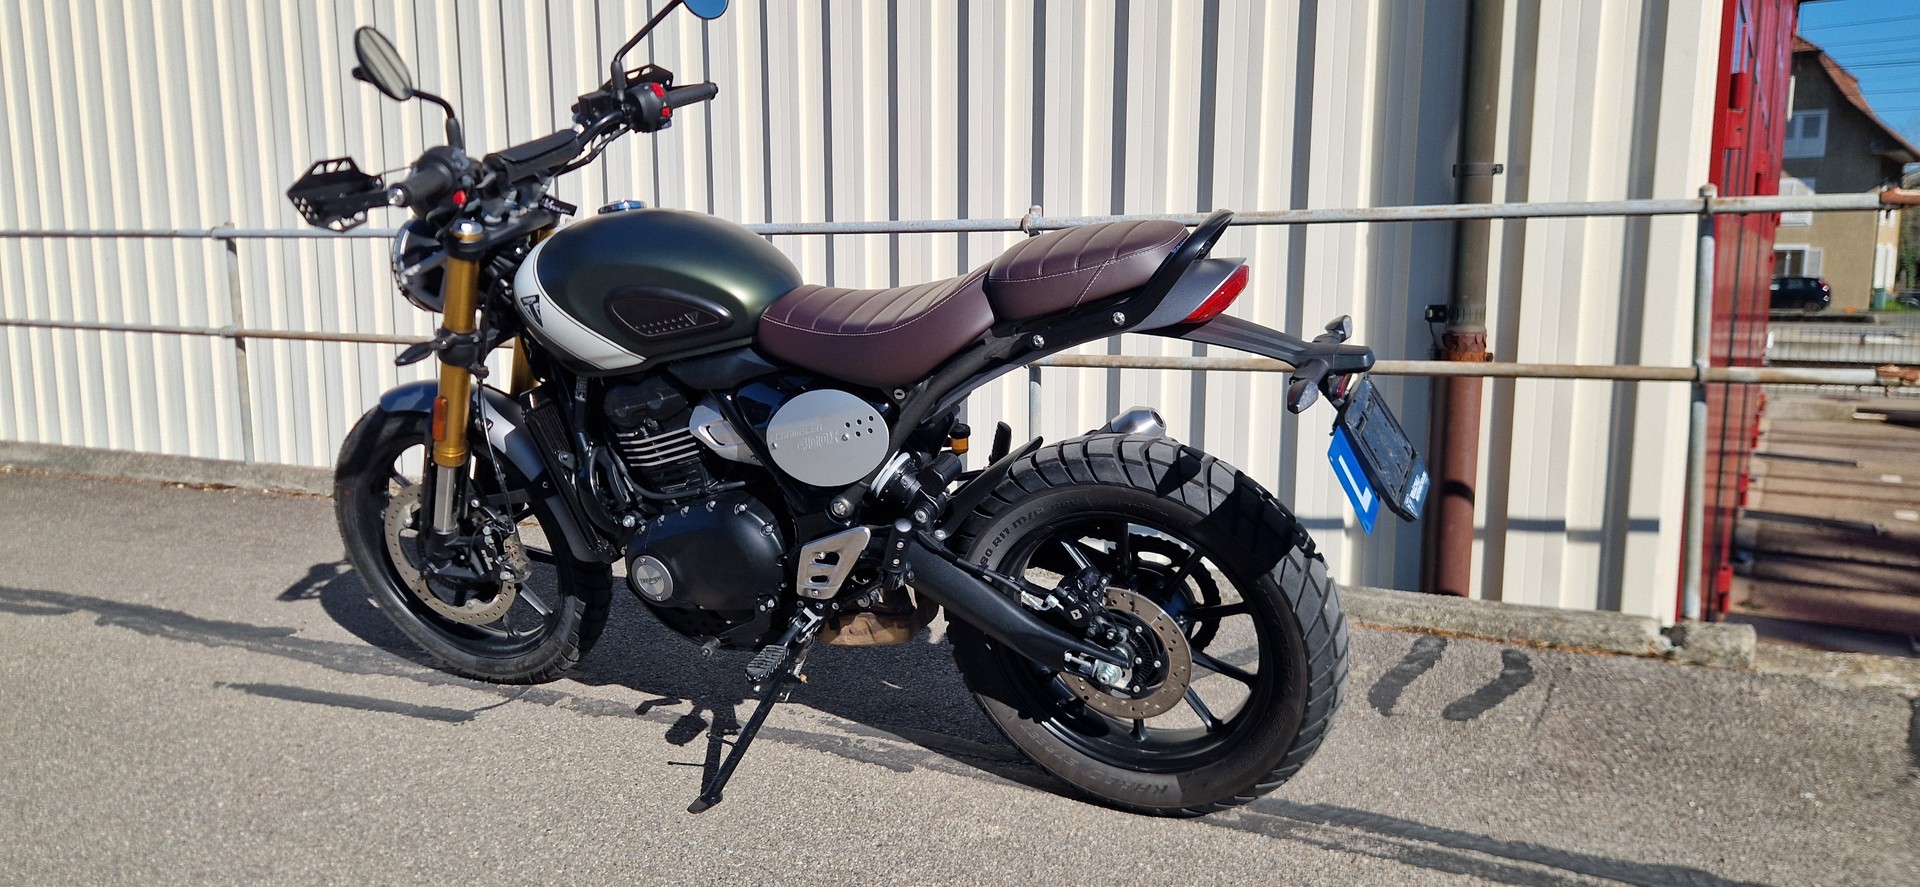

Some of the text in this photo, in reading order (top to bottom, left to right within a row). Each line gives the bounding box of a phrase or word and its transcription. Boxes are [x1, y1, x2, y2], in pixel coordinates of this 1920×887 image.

[770, 422, 823, 441] SCRAMBLER
[797, 431, 839, 451] 400X
[1338, 454, 1372, 513] L
